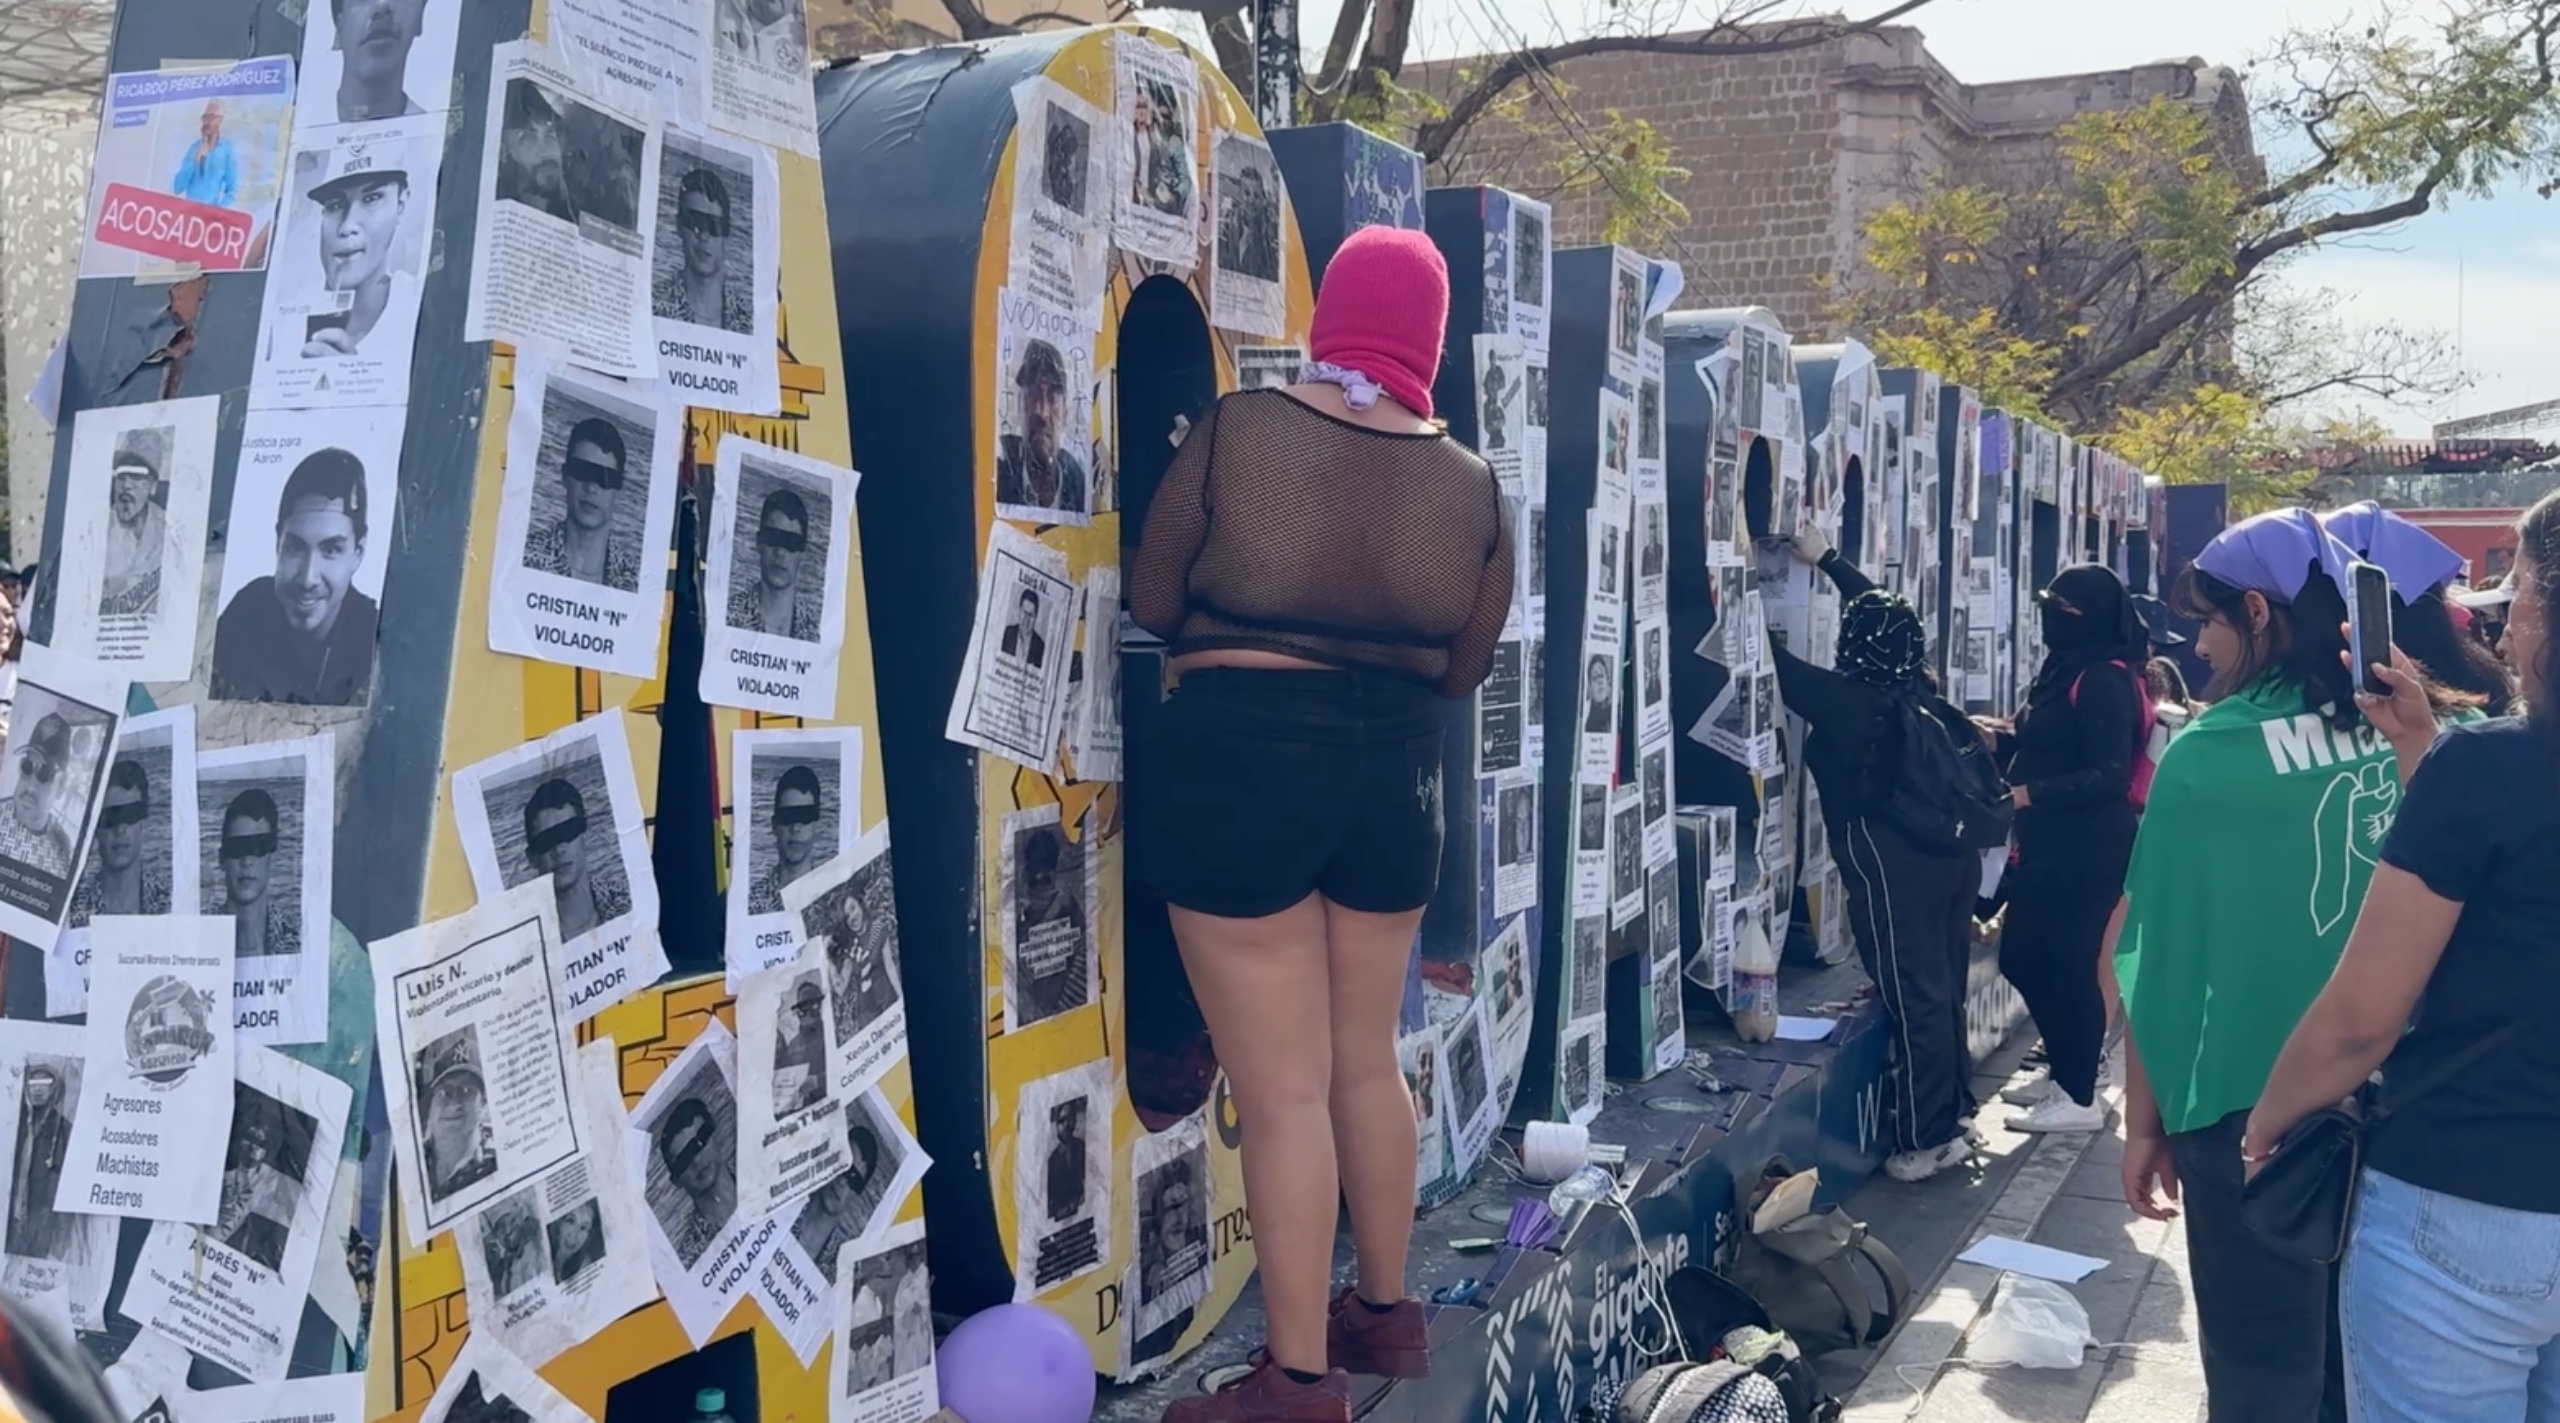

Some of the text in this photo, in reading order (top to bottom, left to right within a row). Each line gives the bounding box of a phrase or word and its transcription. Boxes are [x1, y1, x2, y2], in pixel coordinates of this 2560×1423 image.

[116, 67, 281, 99] RICARDO PÉREZ RODRÍGUEZ
[101, 197, 246, 259] ACOSADOR
[659, 338, 724, 366] CRISTIAN
[669, 369, 739, 396] VIOLADOR
[253, 452, 283, 466] Aaron
[279, 436, 302, 451] para
[526, 592, 600, 623] CRISTIAN
[534, 624, 615, 656] VIOLADOR
[730, 648, 790, 673] CRISTIAN
[737, 676, 800, 701] VIOLADOR
[2260, 701, 2358, 775] Mi
[21, 875, 53, 894] violencia
[234, 979, 264, 1000] TIAN
[406, 961, 467, 1001] Luis N.
[406, 954, 534, 1019] Violentador vicario y deudor
[844, 1012, 903, 1066] Xenia Daniela
[840, 1052, 880, 1088] Cómplice
[880, 1040, 893, 1057] de
[103, 1091, 162, 1117] Agresores
[100, 1126, 159, 1147] Acosadores
[96, 1152, 160, 1177] Machistas
[89, 1183, 143, 1208] Rateros
[189, 1238, 241, 1274] ANDRÉS
[718, 1218, 778, 1295] VIOLADOR
[150, 1268, 167, 1286] Trato
[220, 1306, 279, 1345] deshumanizante
[215, 1289, 255, 1316] psicológica
[503, 1297, 548, 1329] VIOLADOR
[1589, 1232, 1690, 1370] gigante
[169, 1295, 201, 1316] Cosifica
[208, 1313, 219, 1326] las
[221, 1321, 250, 1343] mujeres
[181, 1316, 232, 1348] Manipulación
[203, 1342, 252, 1374] victimización
